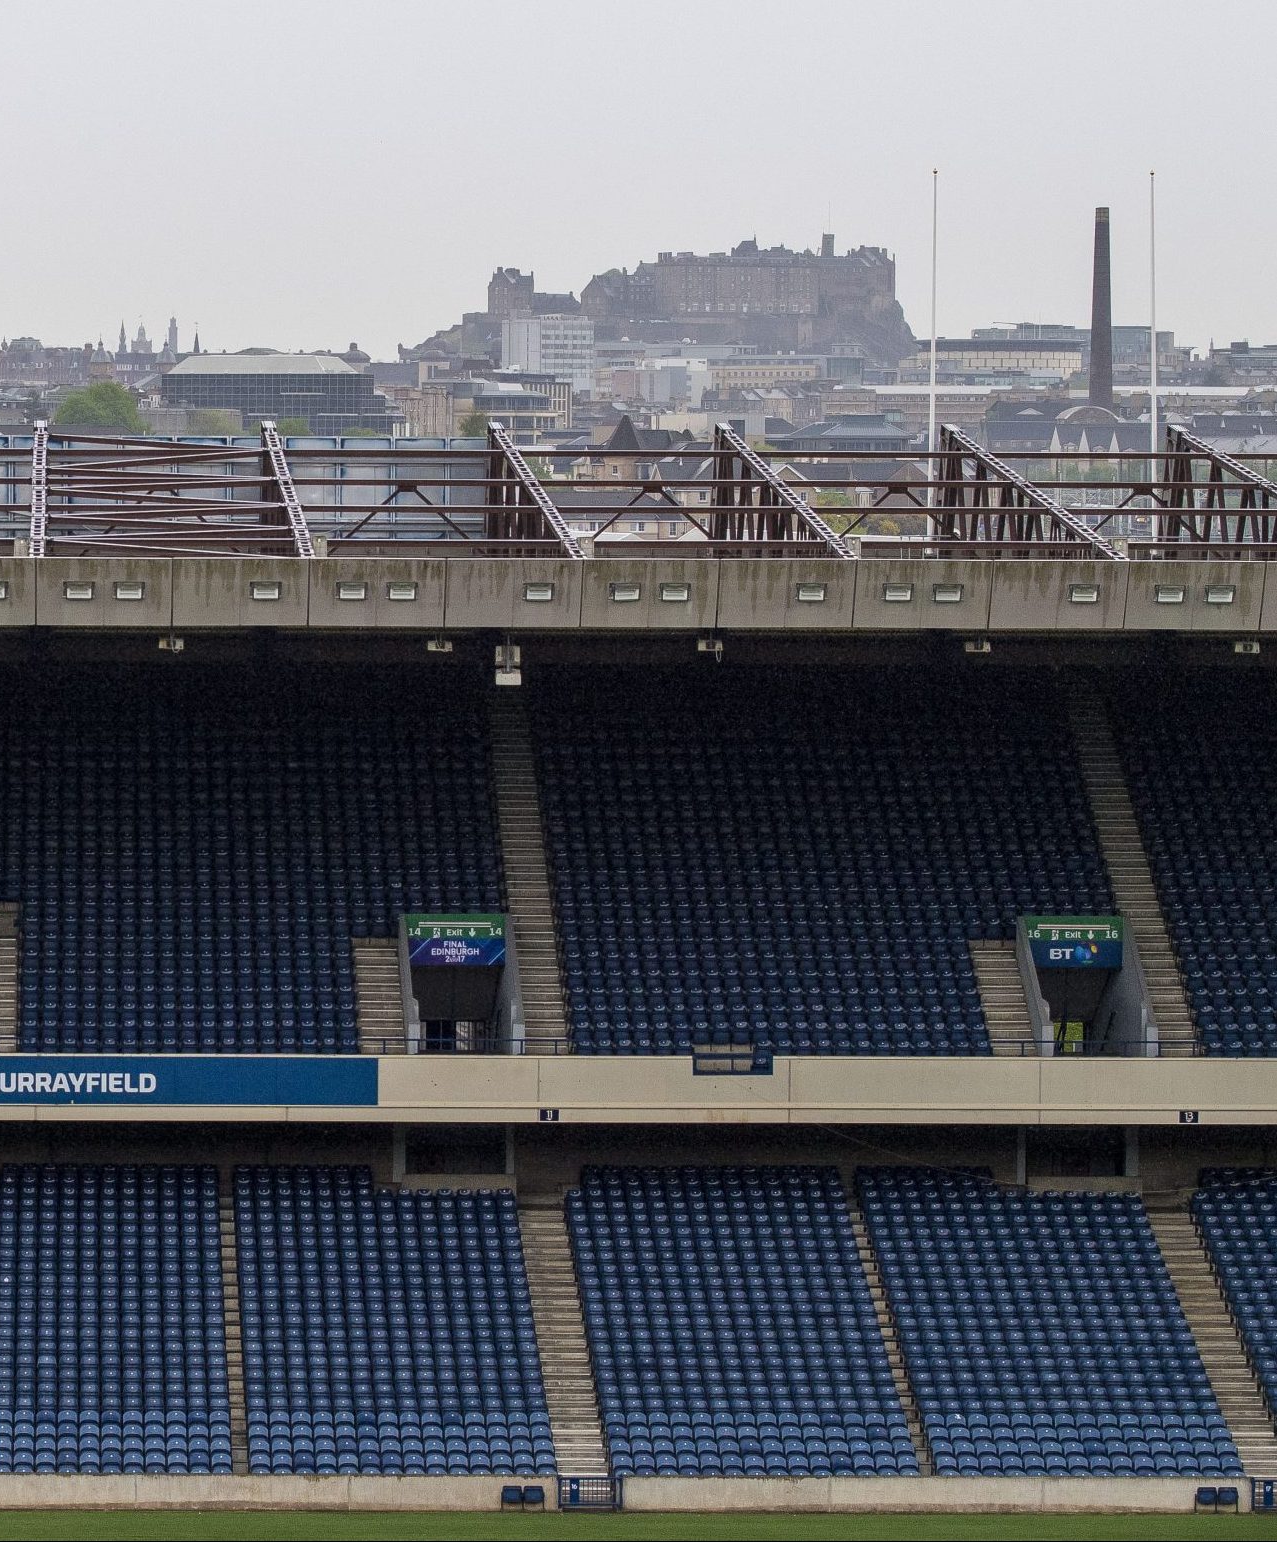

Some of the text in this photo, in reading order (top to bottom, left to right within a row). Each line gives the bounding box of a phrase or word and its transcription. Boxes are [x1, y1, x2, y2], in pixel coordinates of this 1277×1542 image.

[408, 928, 502, 936] 14 Exit 14
[1028, 930, 1118, 939] 16 Exit 16
[443, 940, 467, 948] FINAL
[431, 948, 480, 956] EDINBURGH
[1049, 948, 1074, 960] BT
